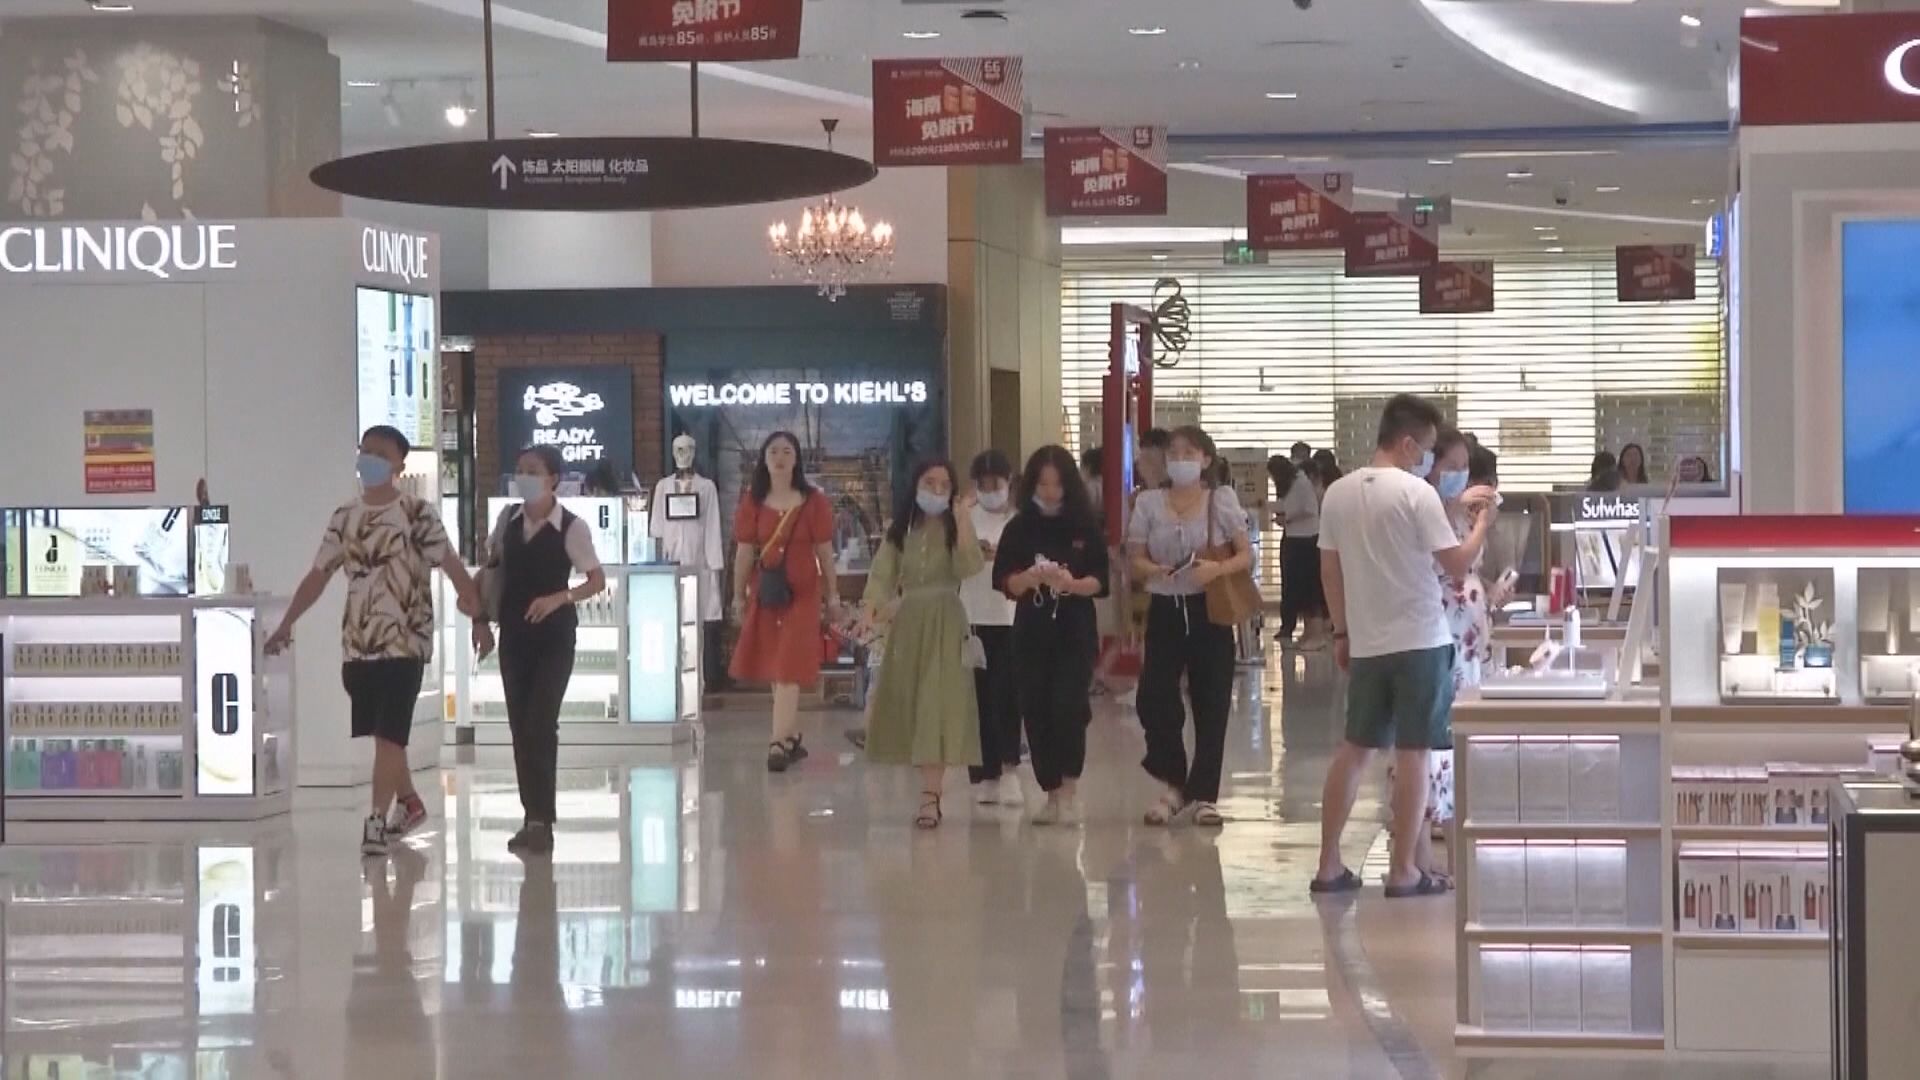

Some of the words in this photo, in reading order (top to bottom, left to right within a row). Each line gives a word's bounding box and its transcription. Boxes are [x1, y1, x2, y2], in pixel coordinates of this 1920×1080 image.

[609, 158, 649, 173] 化妆品
[0, 224, 237, 278] CLINIQUE
[362, 228, 428, 284] CLINIQUE
[669, 382, 791, 406] WELCOME
[795, 383, 829, 404] TO
[834, 381, 928, 403] KIEHL'S
[533, 428, 597, 445] READY.
[562, 445, 605, 462] GIFT
